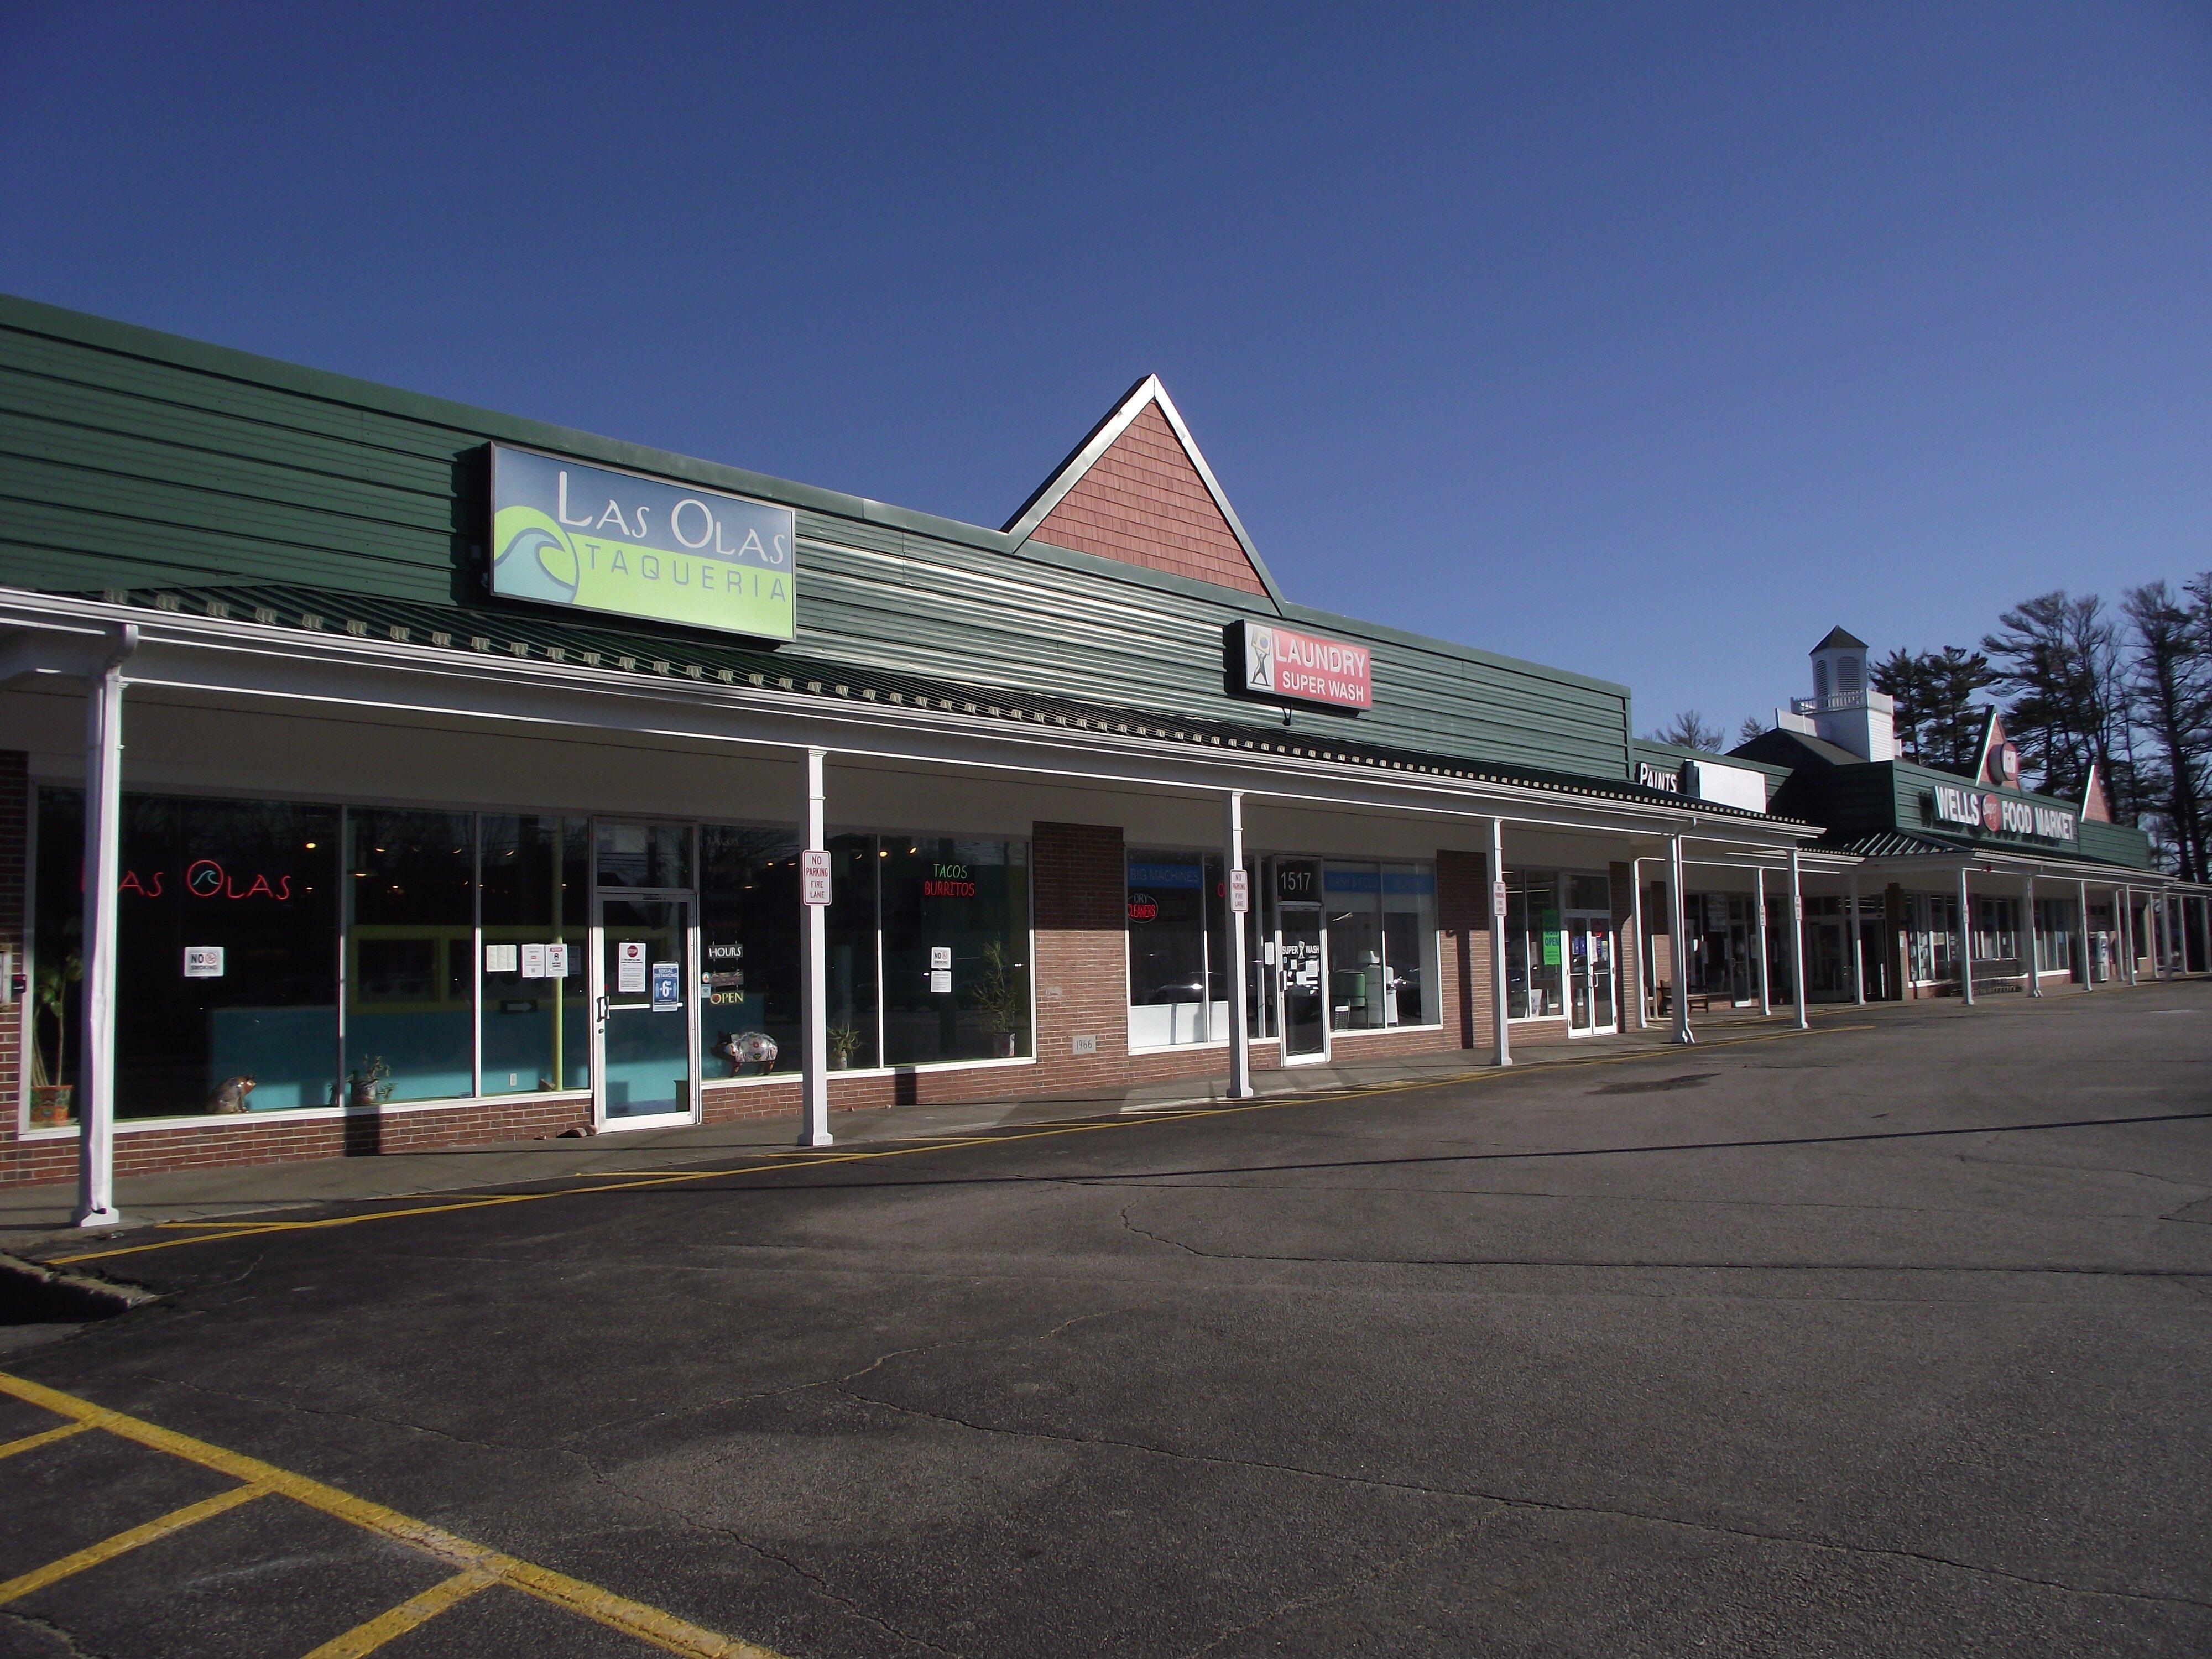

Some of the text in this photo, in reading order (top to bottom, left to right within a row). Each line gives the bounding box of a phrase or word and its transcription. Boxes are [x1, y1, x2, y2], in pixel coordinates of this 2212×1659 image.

[559, 471, 785, 564] LAS OLAS
[585, 544, 786, 602] TAQUERIA
[1275, 635, 1365, 678] LAUNDRY
[1282, 670, 1364, 702] SUPER WASH
[1934, 785, 2074, 840] WELLS FOOD MARKET
[812, 855, 822, 865] NO
[806, 867, 828, 877] PARKING
[933, 863, 967, 879] TACOS
[1130, 868, 1199, 882] BIG MACHINES
[186, 859, 291, 900] OLAS
[1281, 872, 1311, 890] 1517
[925, 881, 974, 896] BURRITOS
[1134, 893, 1148, 904] DRY
[1128, 904, 1155, 918] CLEANERS
[1545, 937, 1559, 946] OPEN
[709, 947, 742, 957] HOURS
[1282, 946, 1298, 954] SUPER
[1305, 945, 1319, 954] WASH
[191, 954, 204, 963] NO
[710, 992, 743, 1004] OPEN
[1076, 1040, 1092, 1050] 1966
